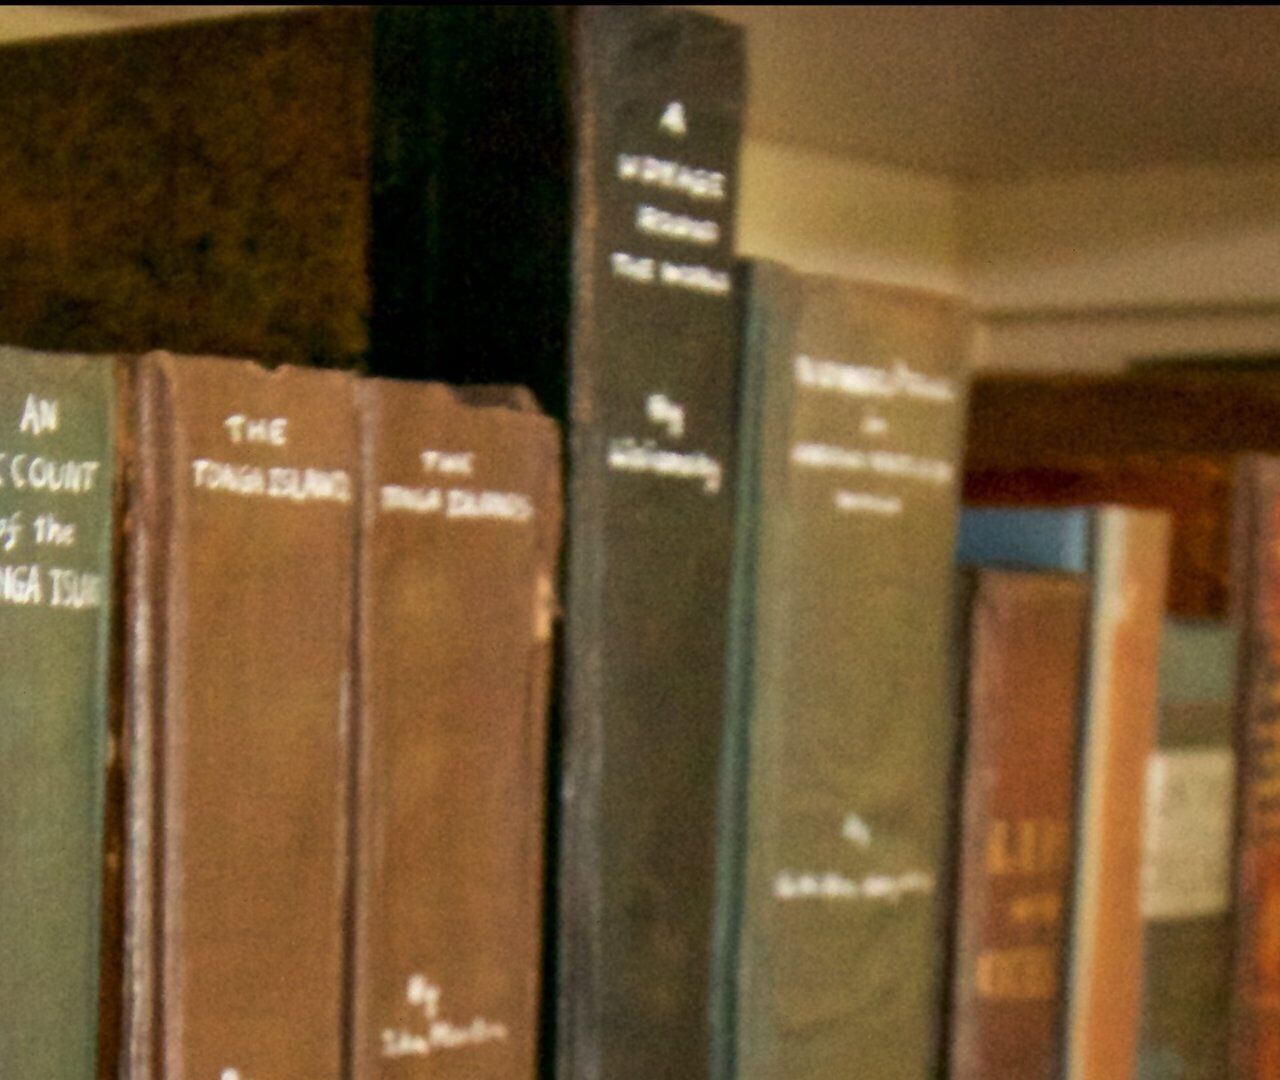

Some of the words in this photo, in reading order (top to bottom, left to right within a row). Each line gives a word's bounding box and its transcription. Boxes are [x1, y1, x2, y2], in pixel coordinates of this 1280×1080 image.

[659, 100, 687, 135] A
[19, 393, 58, 435] AN
[224, 412, 288, 447] THE
[192, 458, 265, 495] TONGA
[33, 513, 75, 547] the
[407, 973, 440, 1018] By
